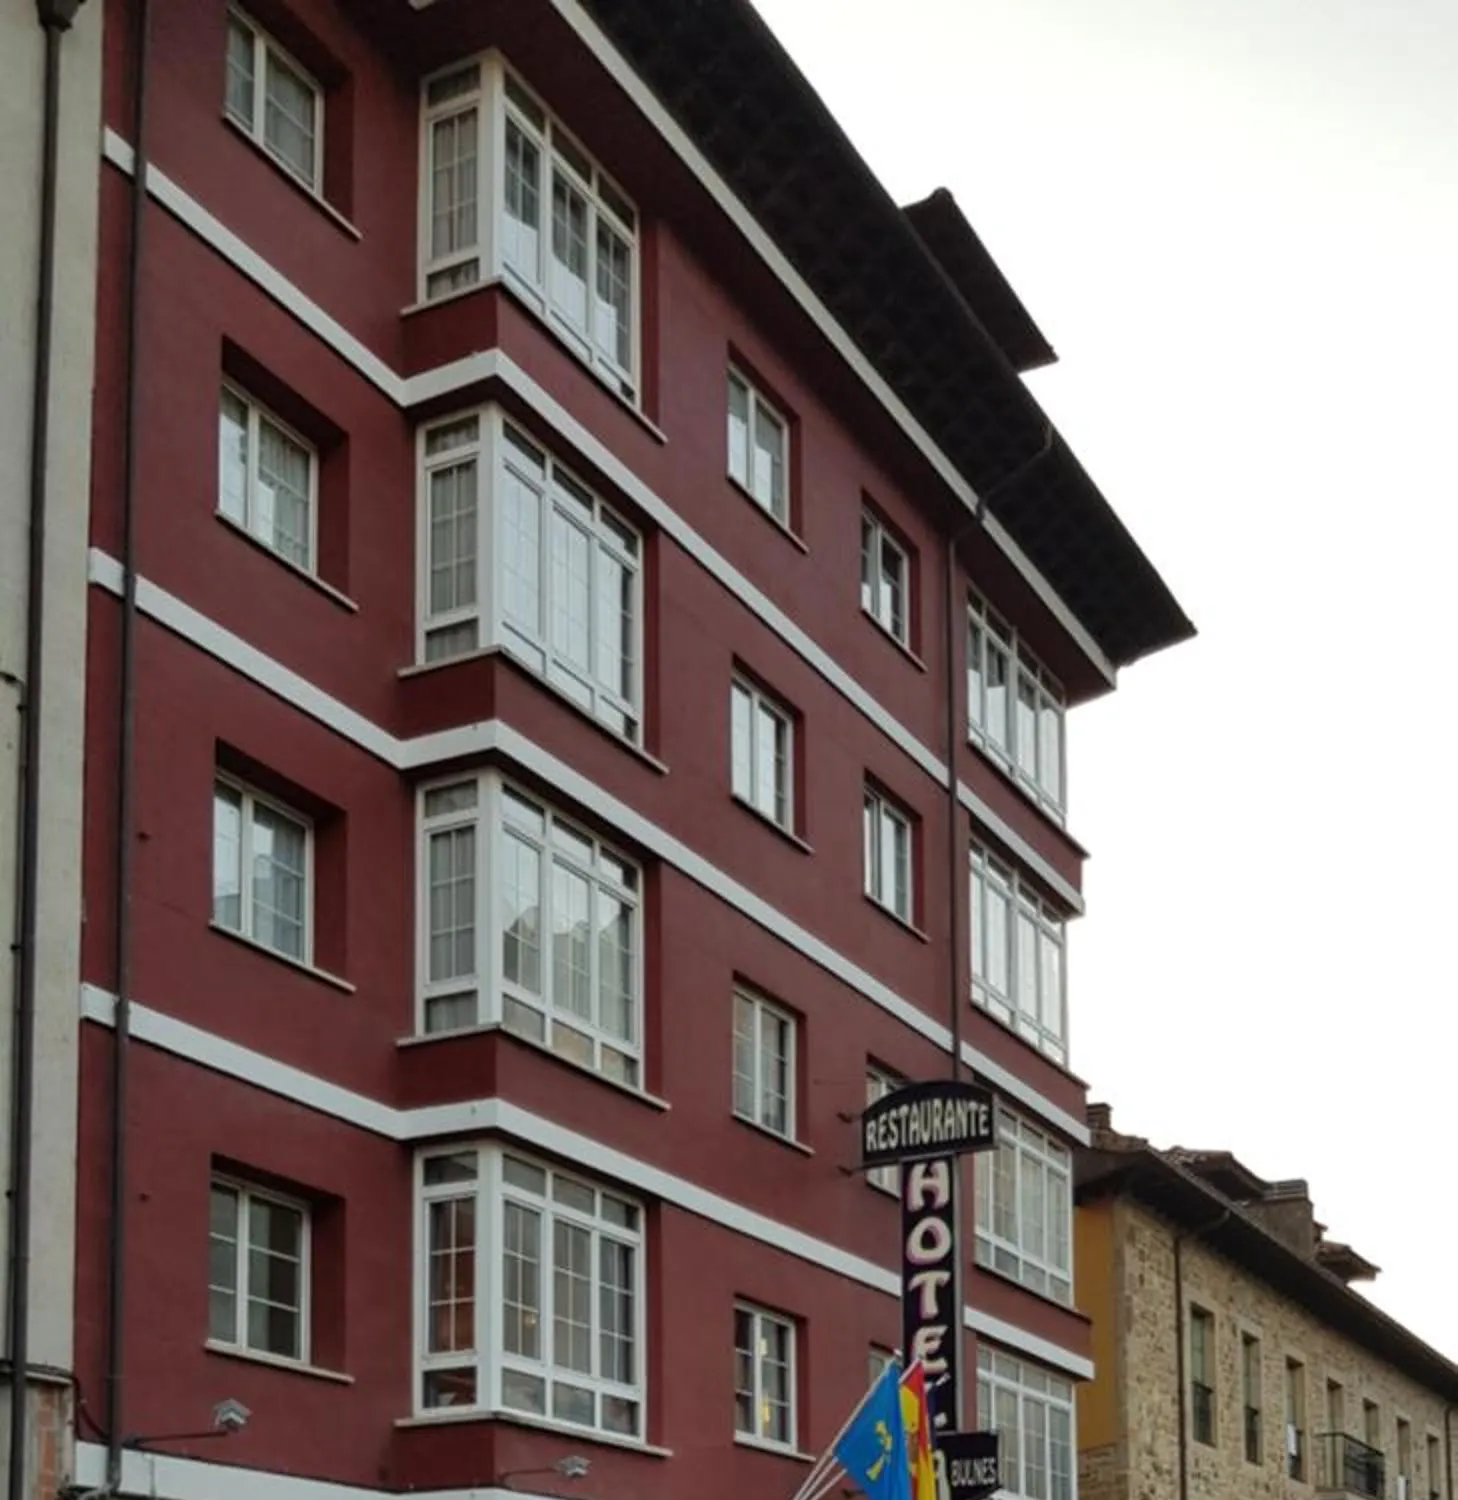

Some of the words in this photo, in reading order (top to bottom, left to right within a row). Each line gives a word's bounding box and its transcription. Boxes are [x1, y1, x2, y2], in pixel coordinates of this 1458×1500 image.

[866, 1098, 989, 1152] RESTAURANTE
[906, 1160, 952, 1428] HOTE
[951, 1457, 996, 1487] BULNES
